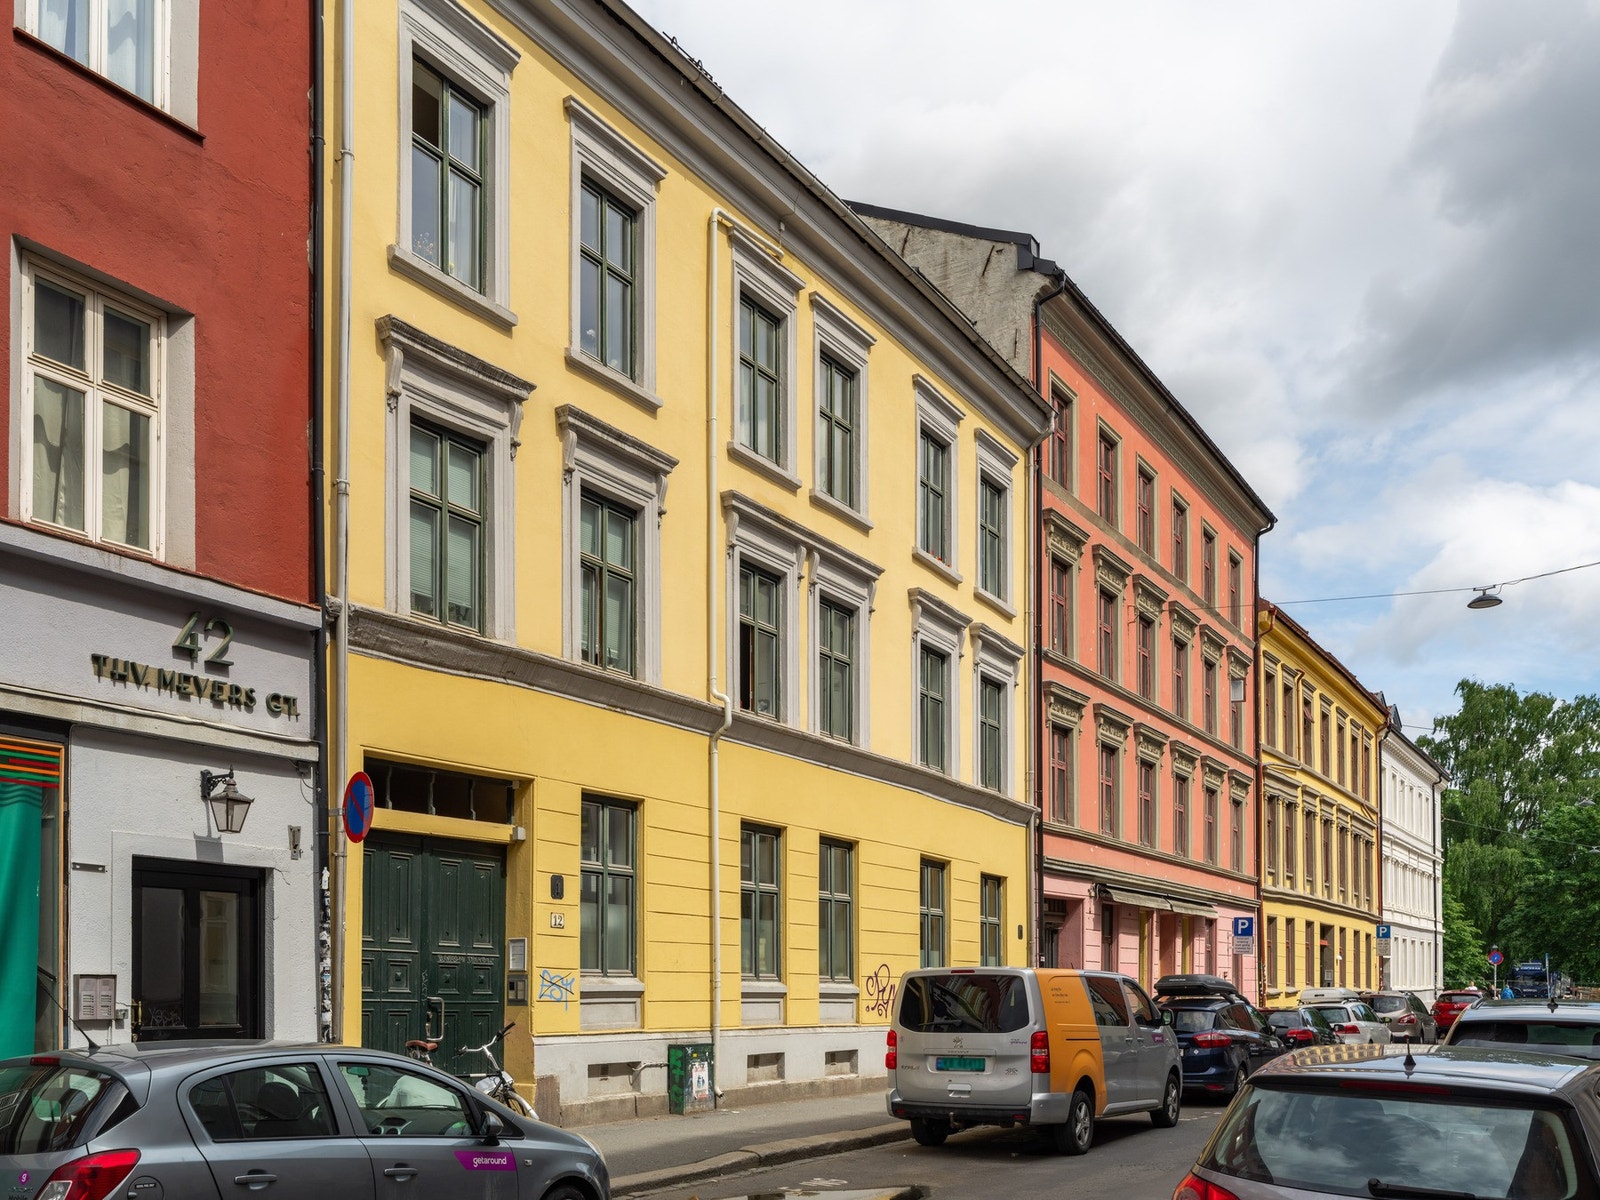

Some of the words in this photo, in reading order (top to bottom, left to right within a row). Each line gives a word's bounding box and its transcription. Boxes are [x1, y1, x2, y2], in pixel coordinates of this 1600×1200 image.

[172, 612, 234, 667] 42
[552, 914, 563, 927] 12
[1238, 919, 1249, 935] P
[1379, 927, 1388, 938] P
[472, 1157, 507, 1168] getaround
